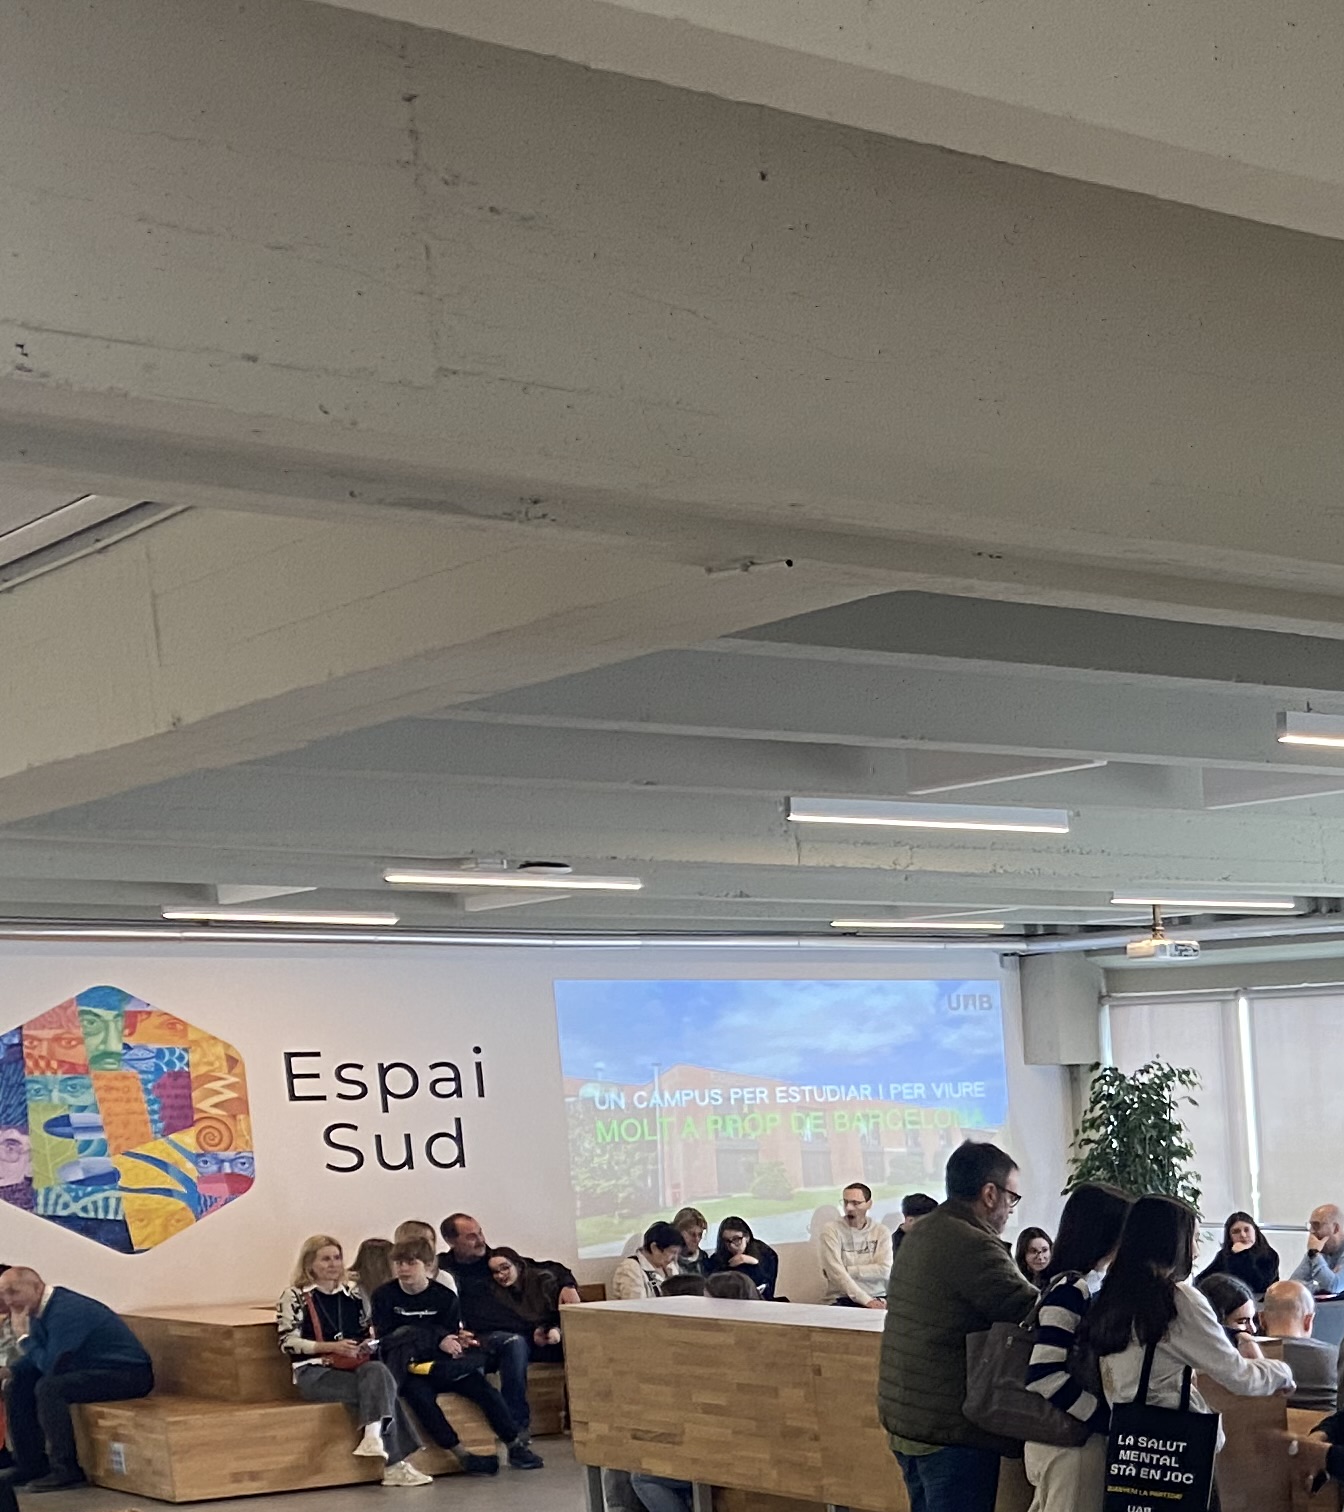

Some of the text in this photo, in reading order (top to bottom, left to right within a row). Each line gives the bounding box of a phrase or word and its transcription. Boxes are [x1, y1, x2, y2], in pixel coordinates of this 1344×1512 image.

[947, 994, 992, 1011] UAB
[283, 1046, 485, 1113] Espai
[594, 1082, 986, 1110] UN CAMPUS PER ESTUDIAR I PER VIURE
[595, 1108, 986, 1143] MOLT A PROP DE BARCELONA
[323, 1117, 466, 1172] Sud
[1117, 1434, 1188, 1453] LA SALUT
[1119, 1449, 1180, 1468] MENTAL
[1110, 1463, 1195, 1484] STÀ EN JOC
